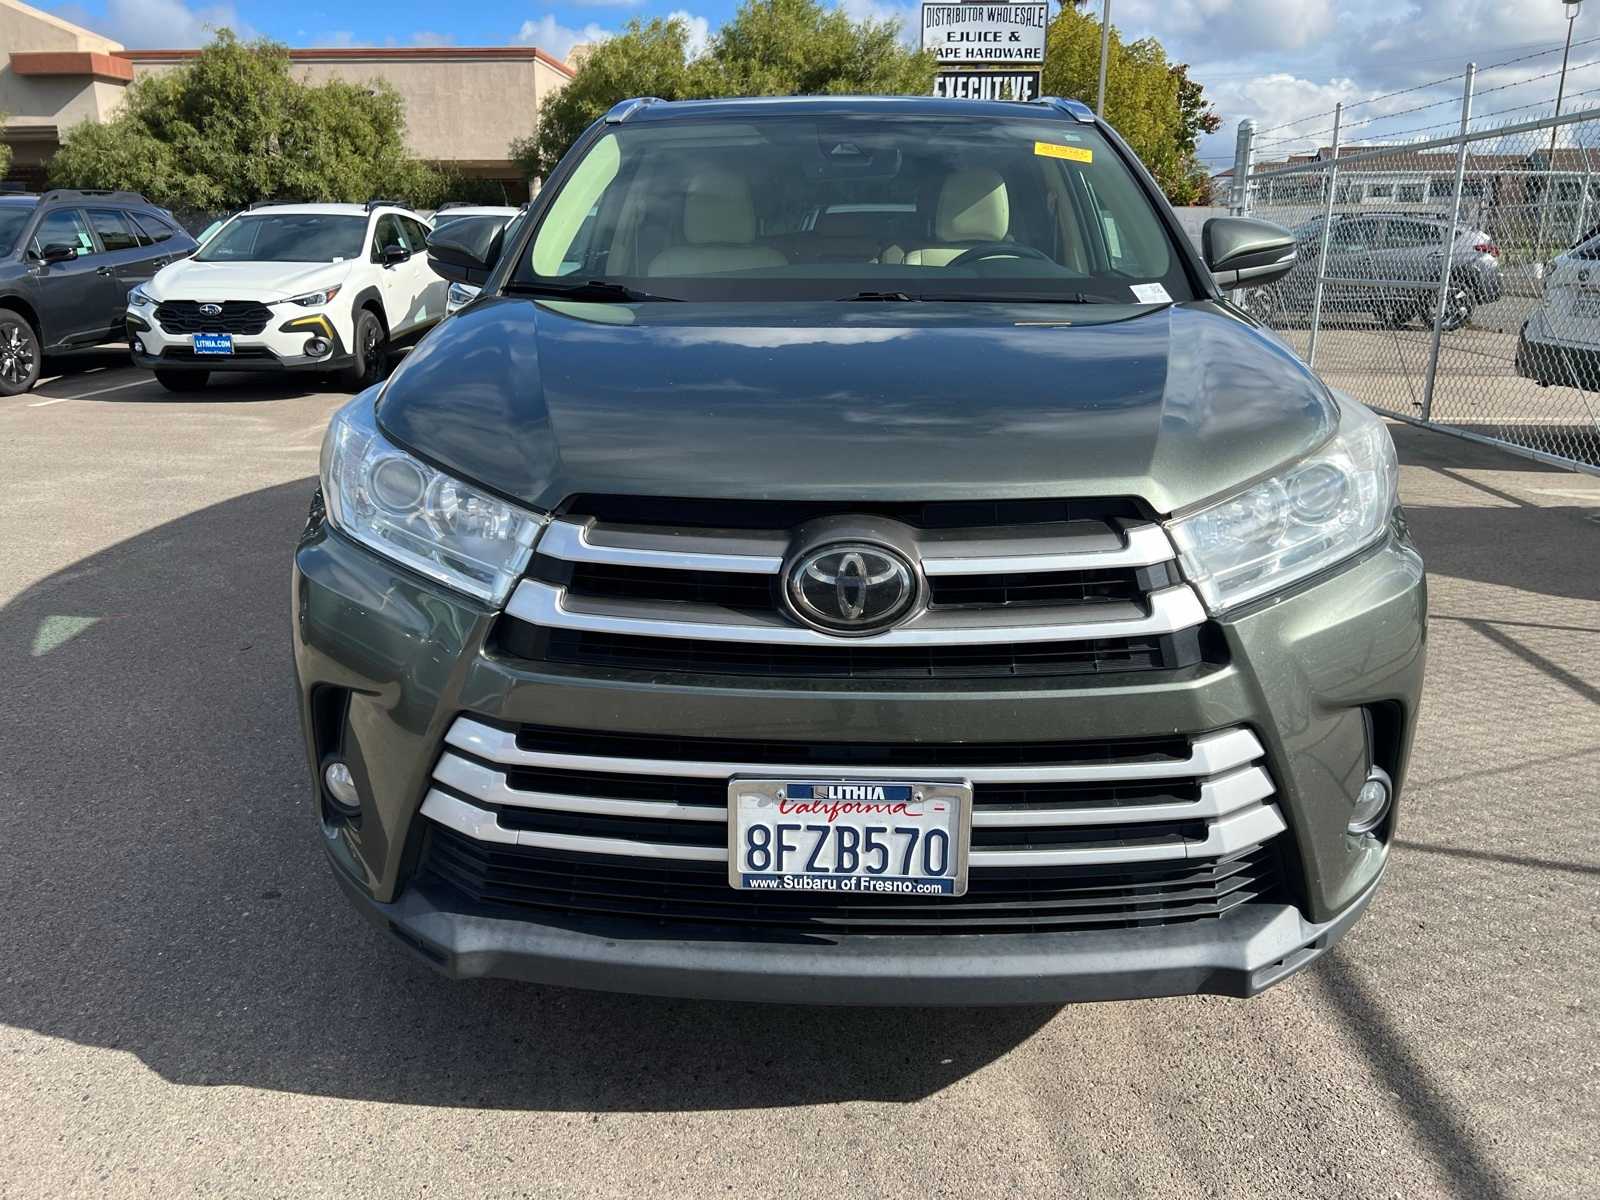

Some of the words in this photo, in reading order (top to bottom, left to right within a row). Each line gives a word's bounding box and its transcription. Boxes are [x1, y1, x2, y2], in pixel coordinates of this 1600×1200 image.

[926, 7, 984, 28] DISTRIBUTOR
[987, 7, 1045, 28] WHOLESALE
[947, 31, 1002, 42] EJUICE
[1009, 31, 1021, 42] &
[965, 47, 1041, 58] HARDWARE
[196, 339, 231, 348] LITHIA.COM
[828, 785, 886, 800] LITHIA
[779, 799, 924, 823] California
[747, 824, 949, 877] 8FZB570
[841, 876, 857, 890] of
